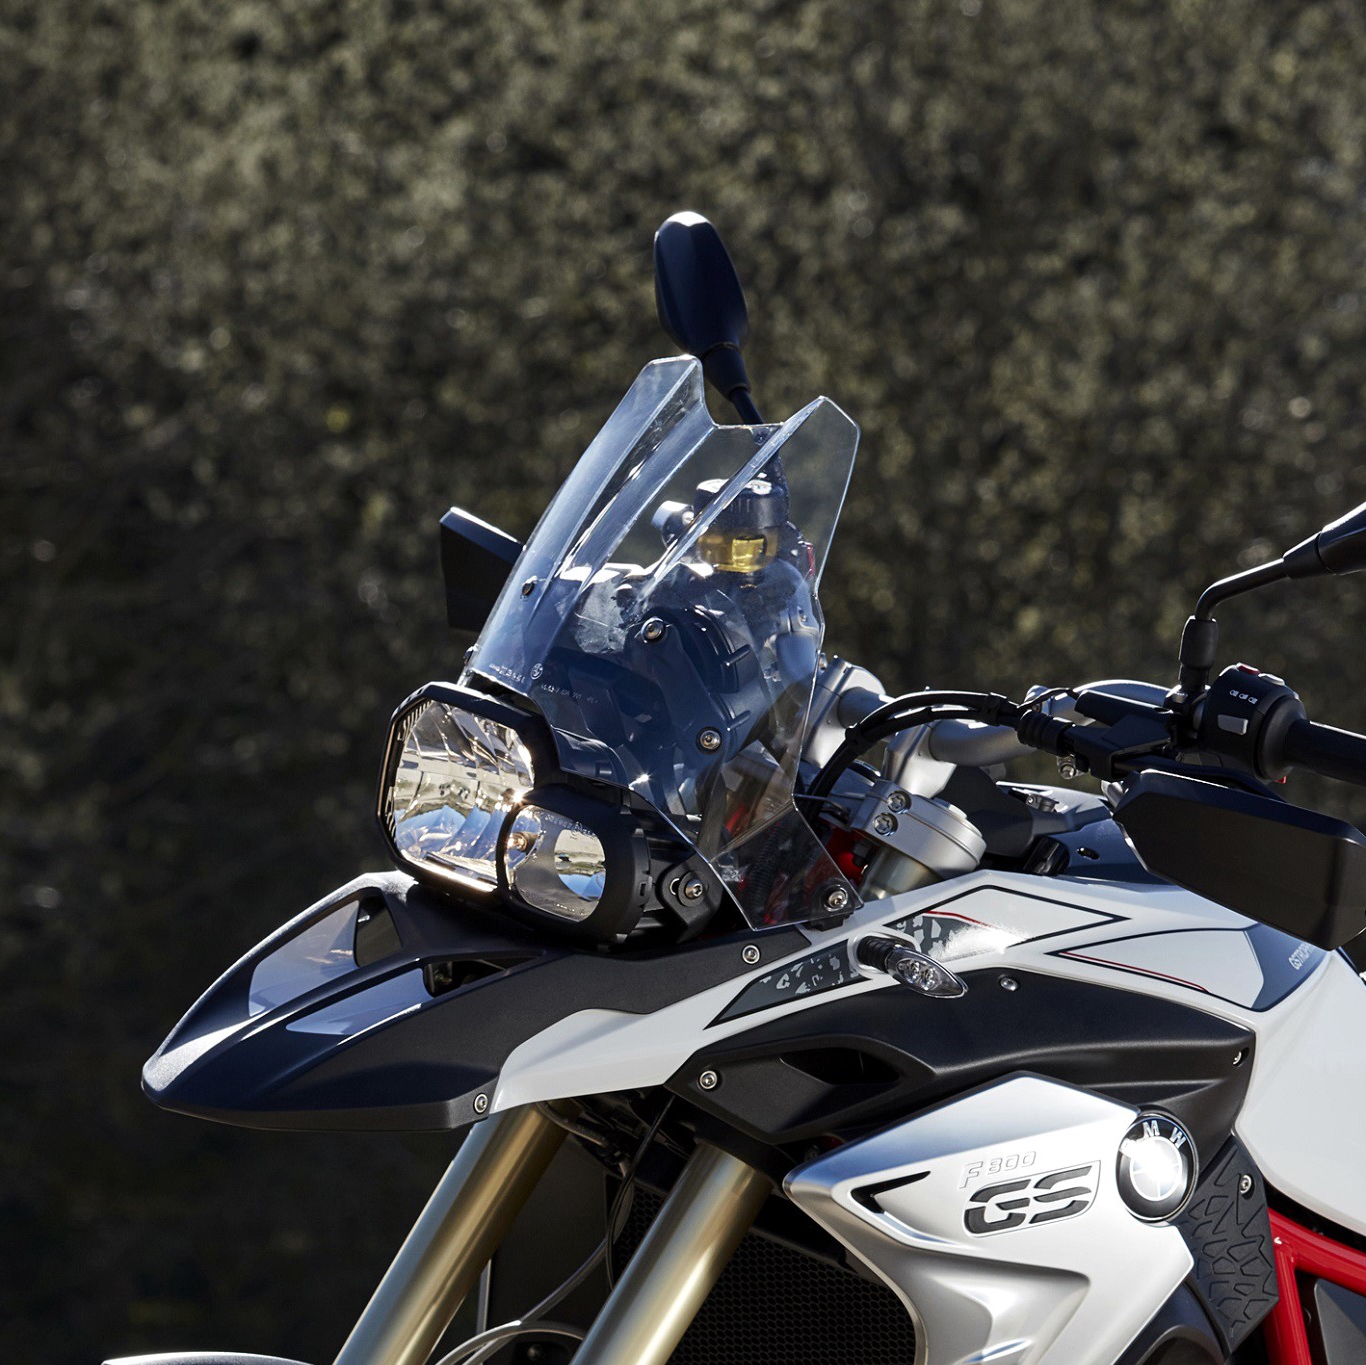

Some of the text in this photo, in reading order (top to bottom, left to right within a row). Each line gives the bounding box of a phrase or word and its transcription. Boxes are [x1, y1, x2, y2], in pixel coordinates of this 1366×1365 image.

[1119, 1119, 1187, 1158] BMW
[959, 1150, 1037, 1189] F 800
[963, 1165, 1093, 1235] GS
